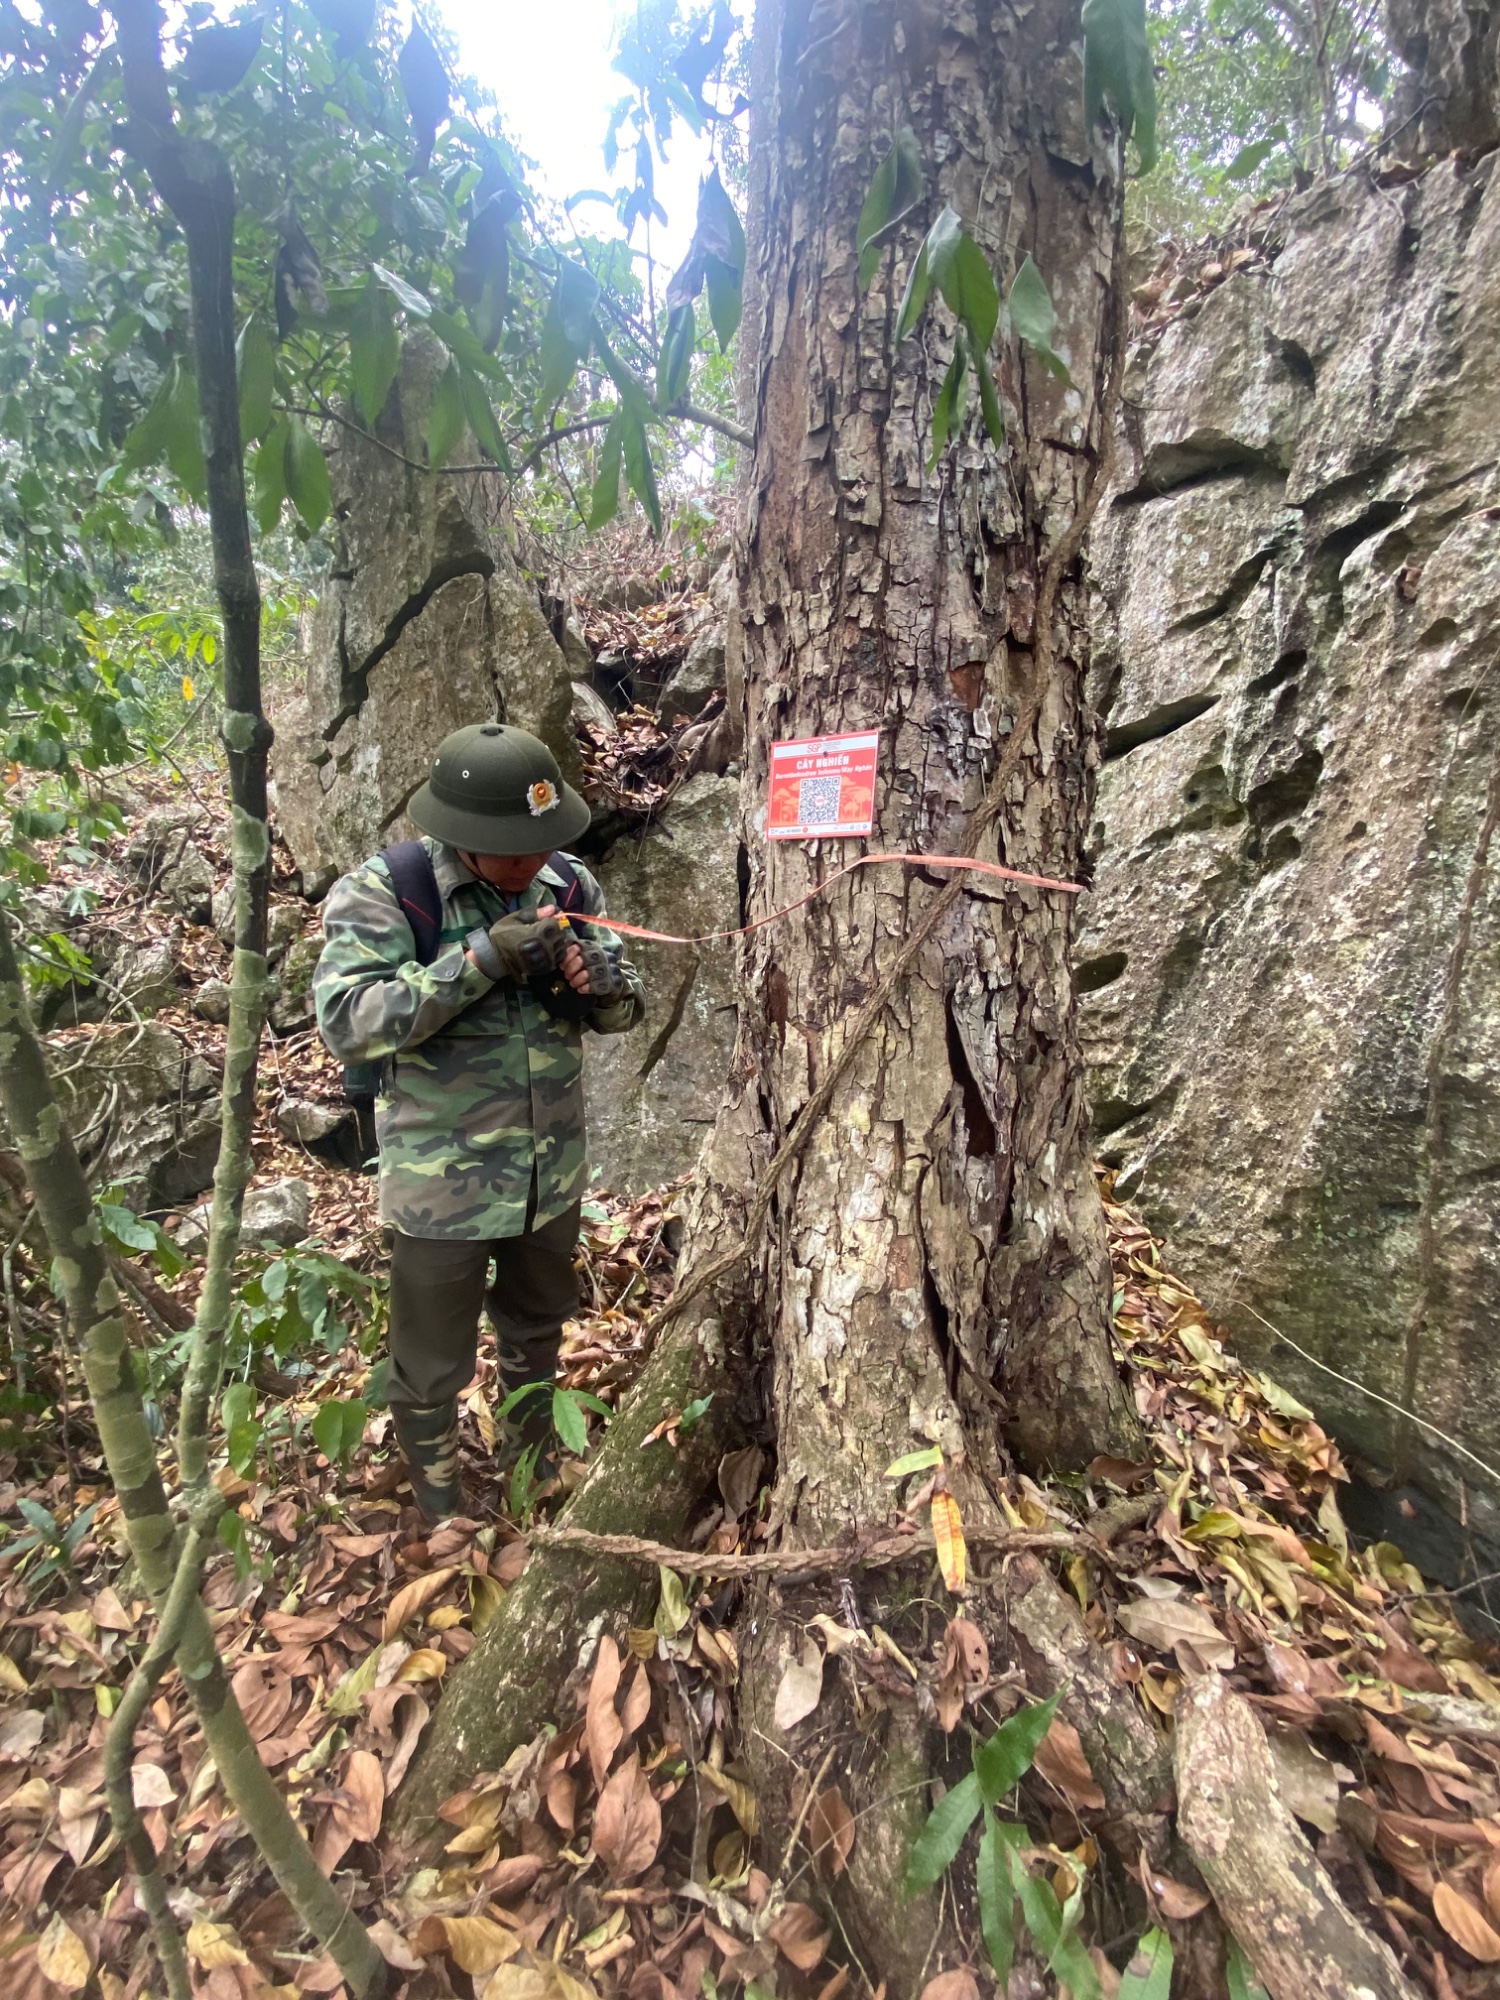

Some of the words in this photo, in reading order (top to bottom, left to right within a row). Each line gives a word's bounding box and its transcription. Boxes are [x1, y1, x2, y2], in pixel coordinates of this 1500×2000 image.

[807, 743, 822, 753] SGP
[796, 759, 814, 770] CÂY
[816, 753, 849, 768] NGHIẾN
